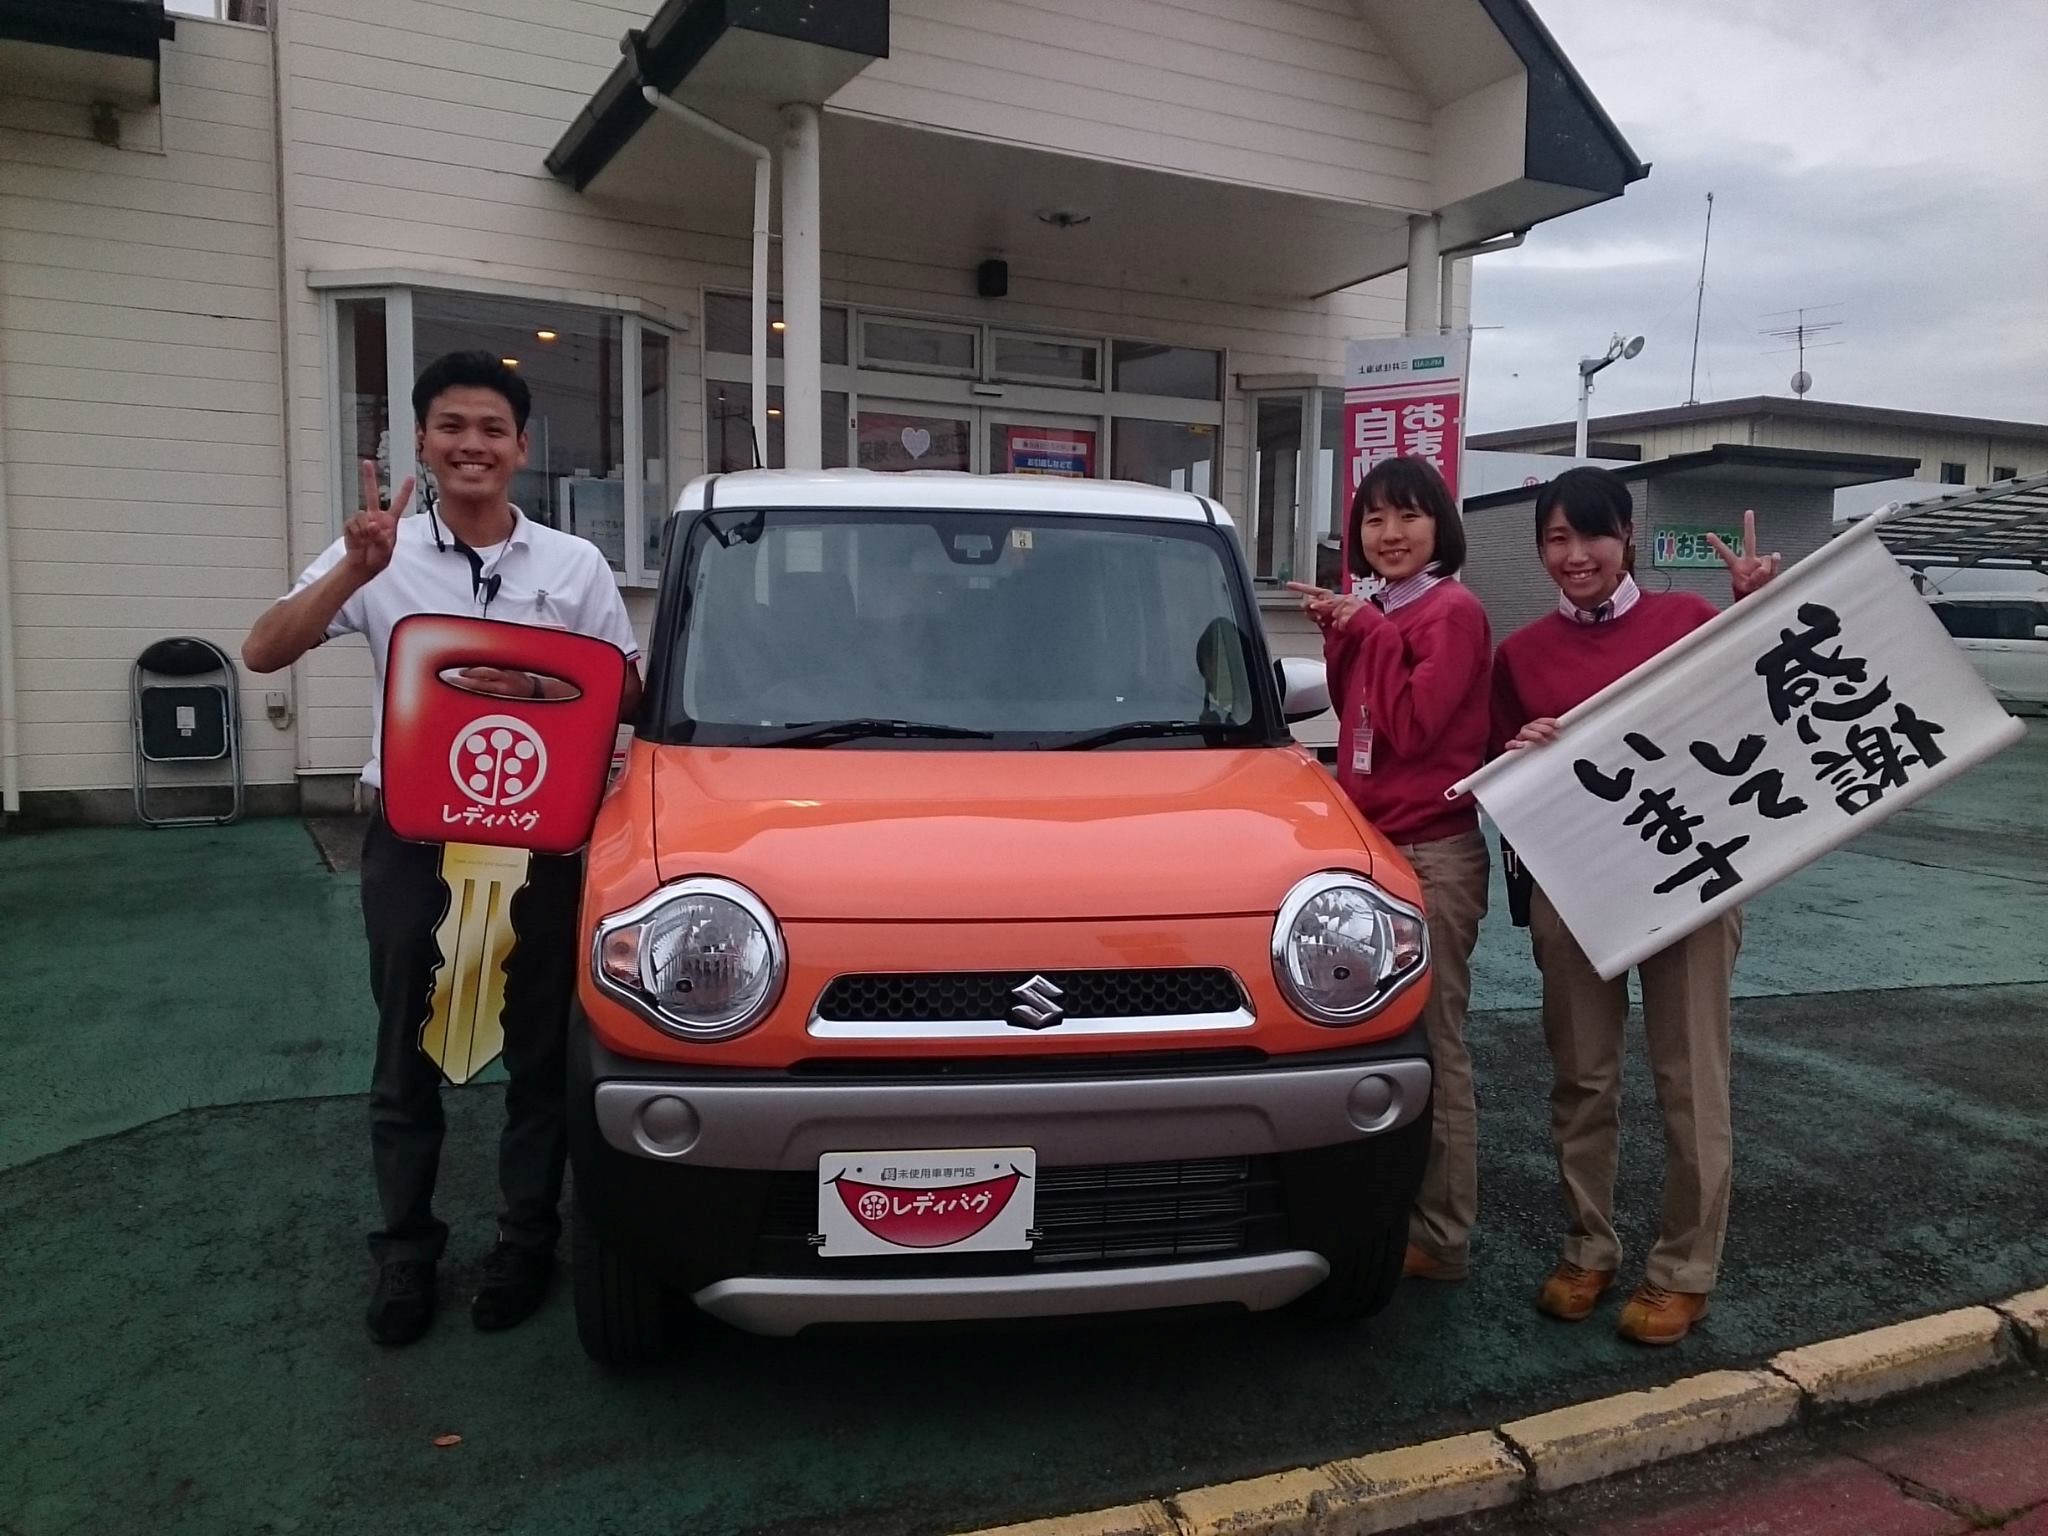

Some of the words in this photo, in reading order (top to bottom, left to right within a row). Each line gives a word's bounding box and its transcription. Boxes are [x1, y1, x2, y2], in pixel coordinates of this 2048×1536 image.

[442, 804, 541, 831] レディバグ
[892, 1190, 993, 1216] レディバグ
